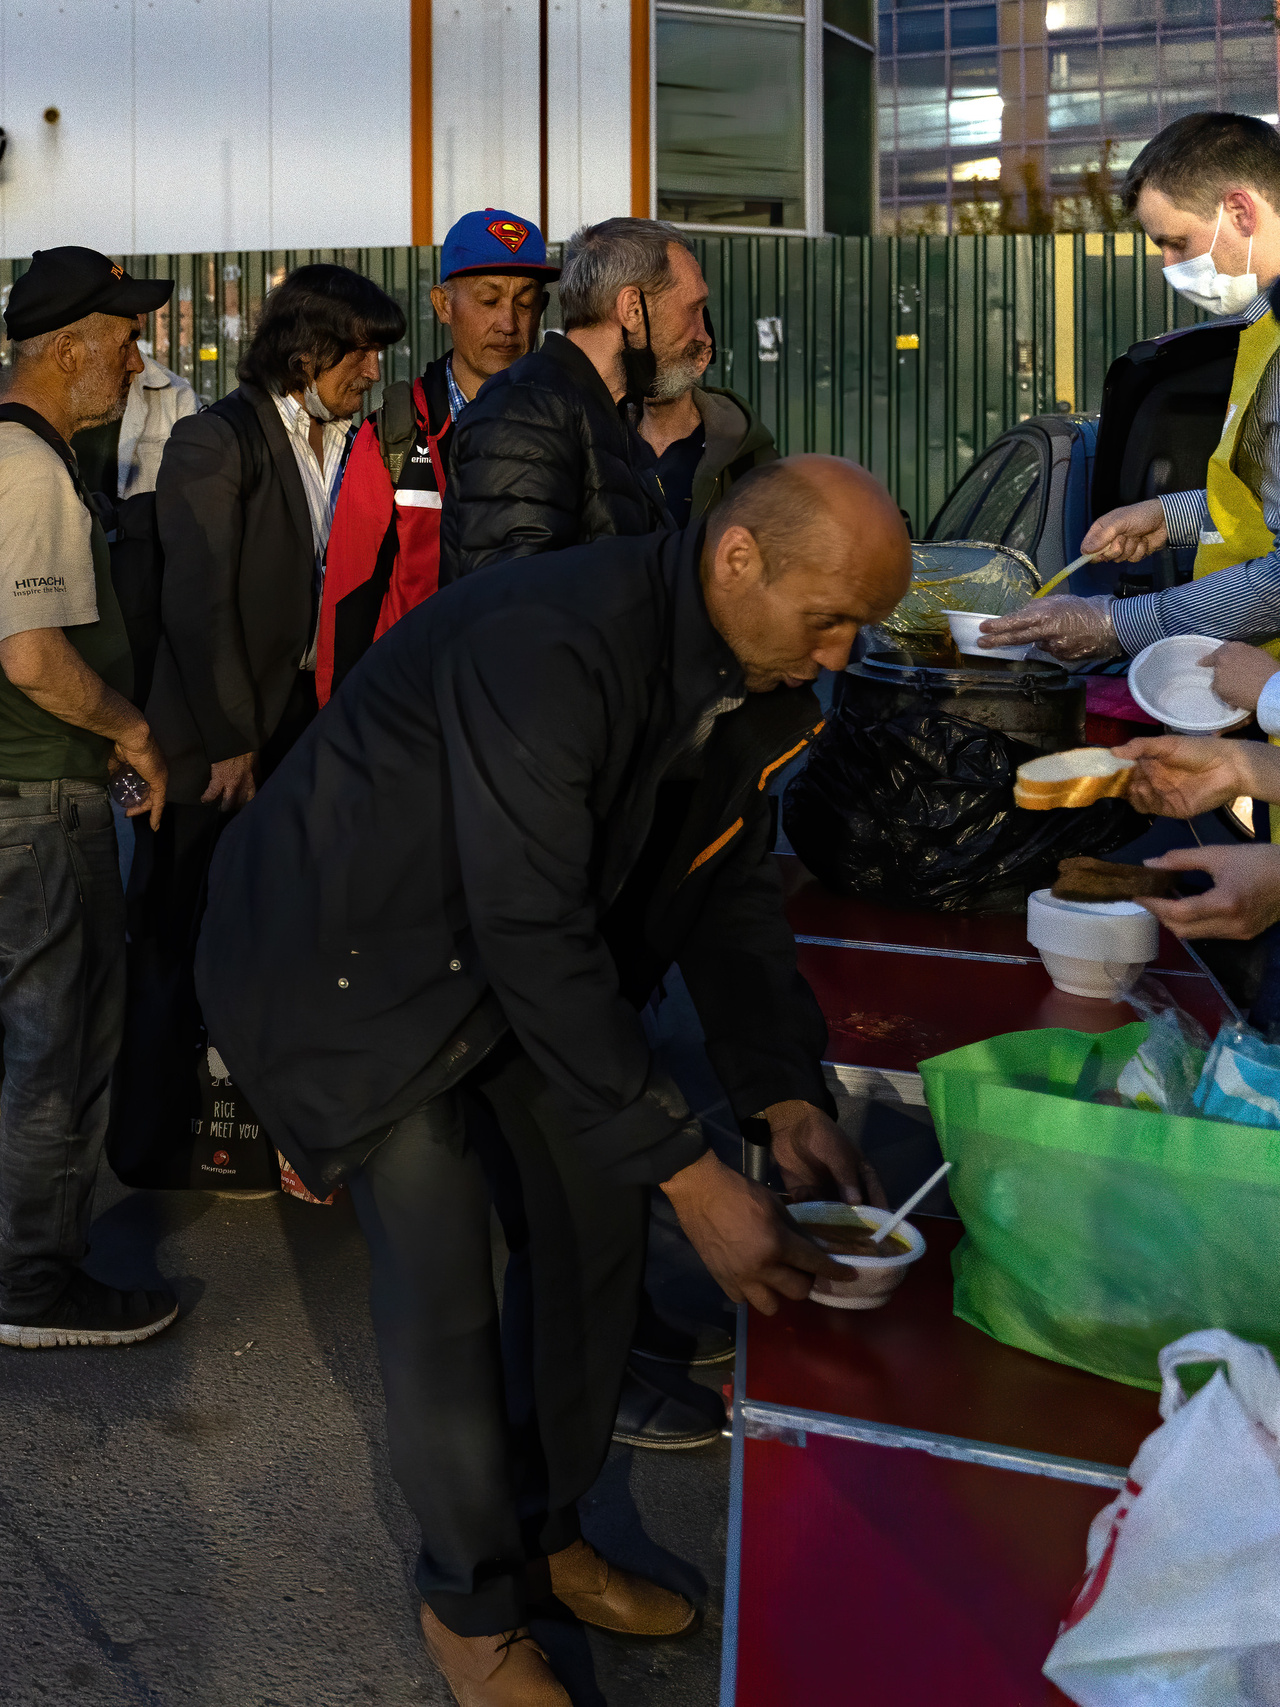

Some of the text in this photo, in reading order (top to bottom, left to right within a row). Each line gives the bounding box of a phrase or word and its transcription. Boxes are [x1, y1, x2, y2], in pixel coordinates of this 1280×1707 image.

[15, 576, 65, 589] HITACHI
[13, 589, 41, 597] Inspire
[210, 1121, 234, 1138] MEET
[239, 1123, 259, 1140] YOU
